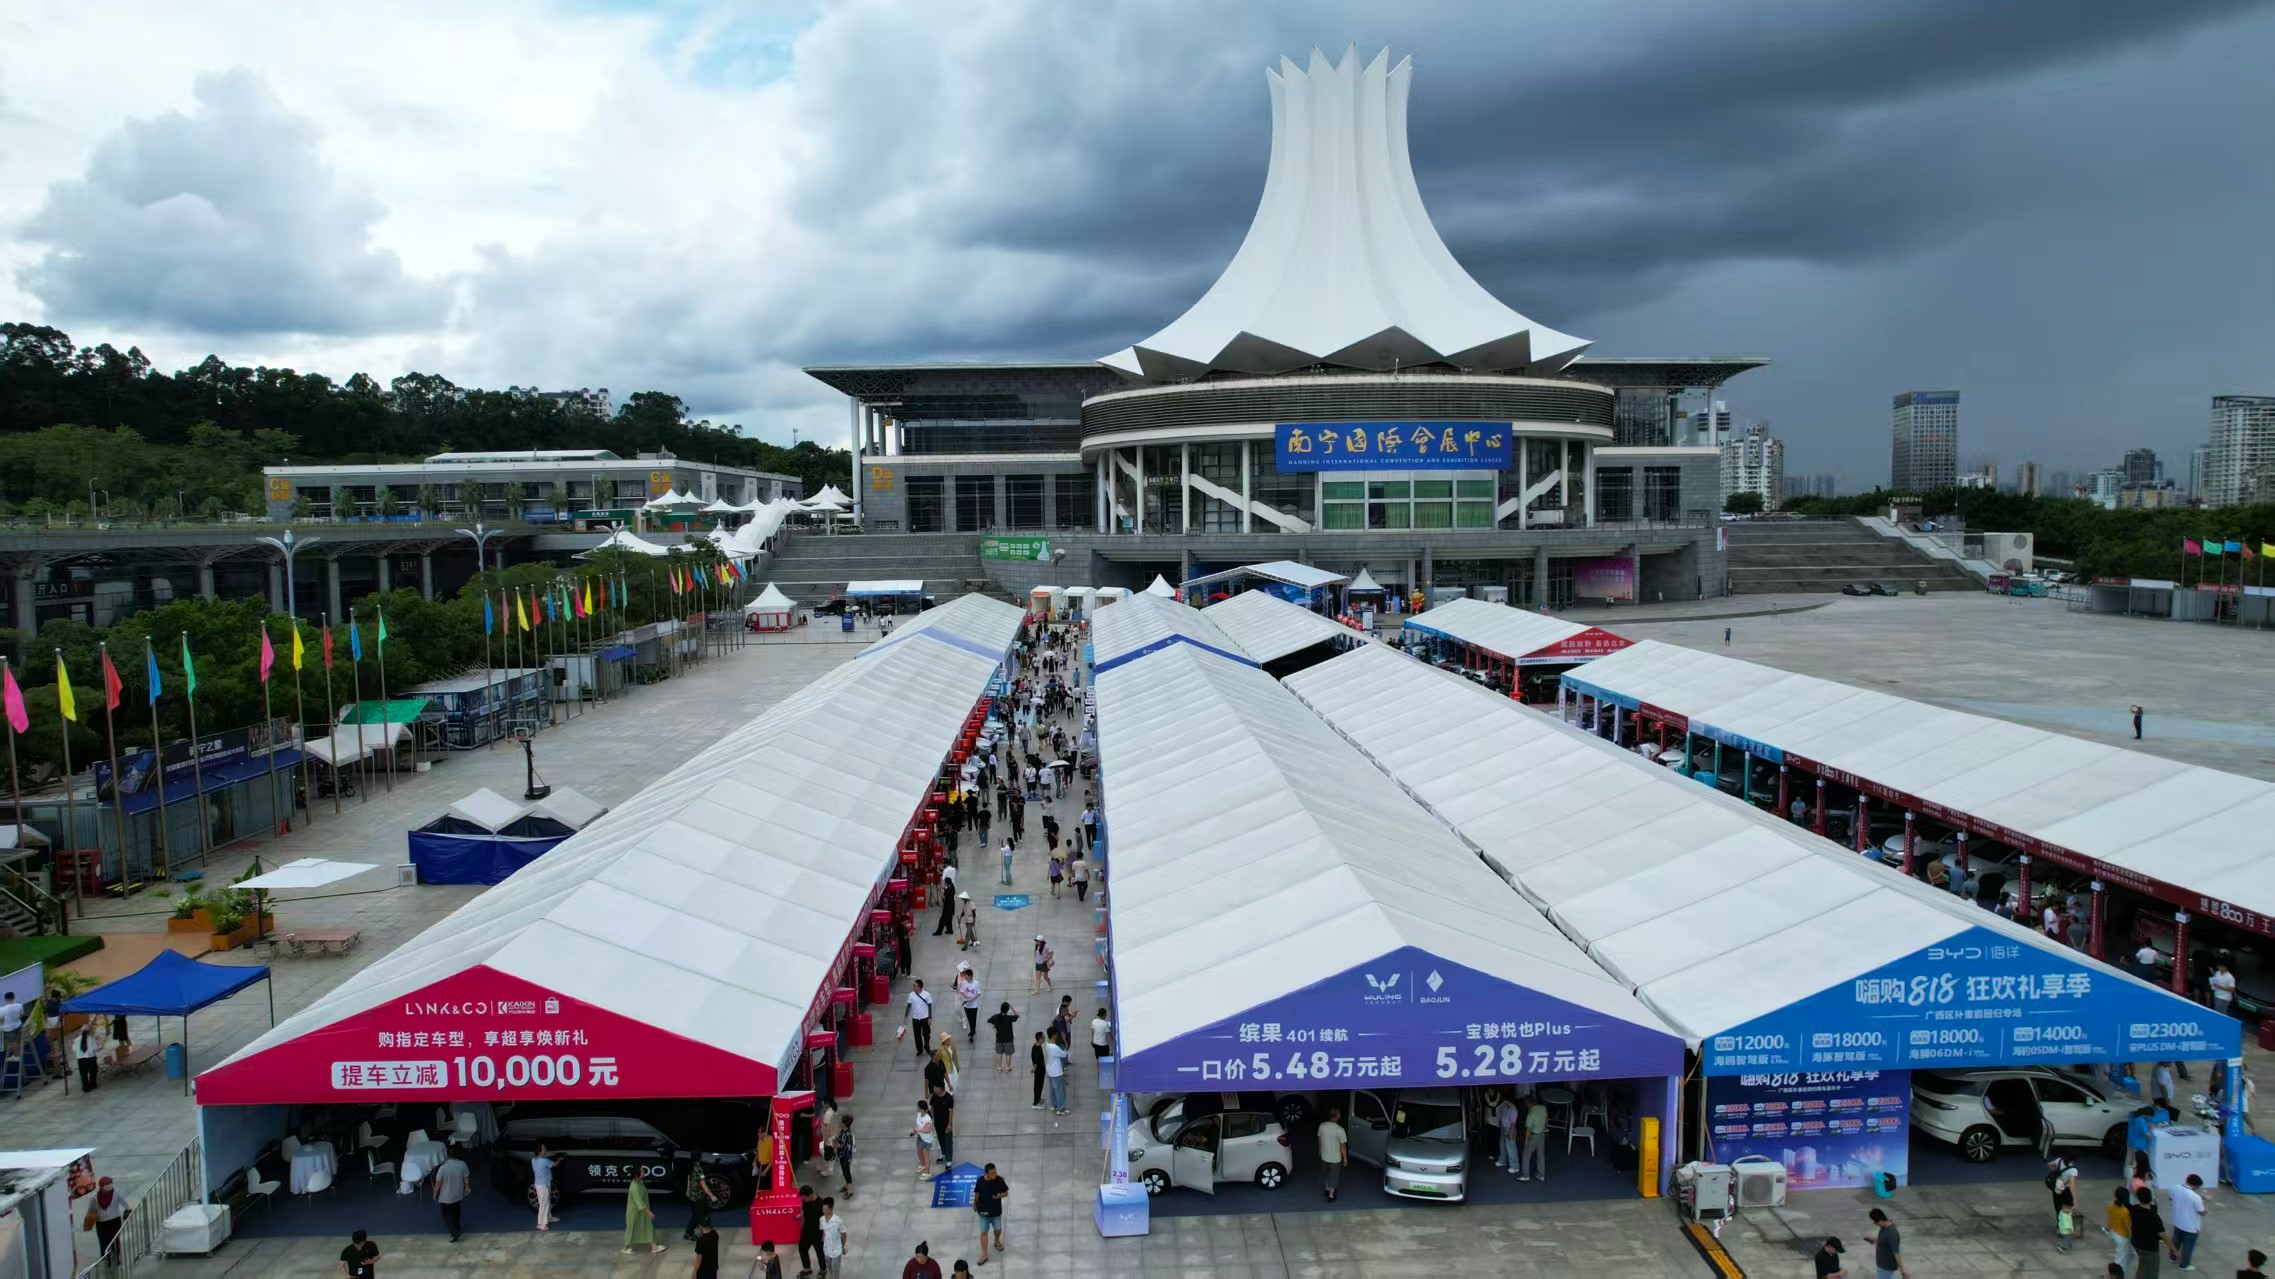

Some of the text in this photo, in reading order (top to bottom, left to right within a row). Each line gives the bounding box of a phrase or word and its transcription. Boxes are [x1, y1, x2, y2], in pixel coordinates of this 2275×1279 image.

[1927, 945, 2021, 961] BYD 海洋
[405, 1001, 488, 1015] LYNK&CO
[1420, 996, 1451, 1004] BAOJUN
[1239, 1023, 1348, 1043] 缤果 401 续航
[340, 1064, 439, 1087] 提车立减
